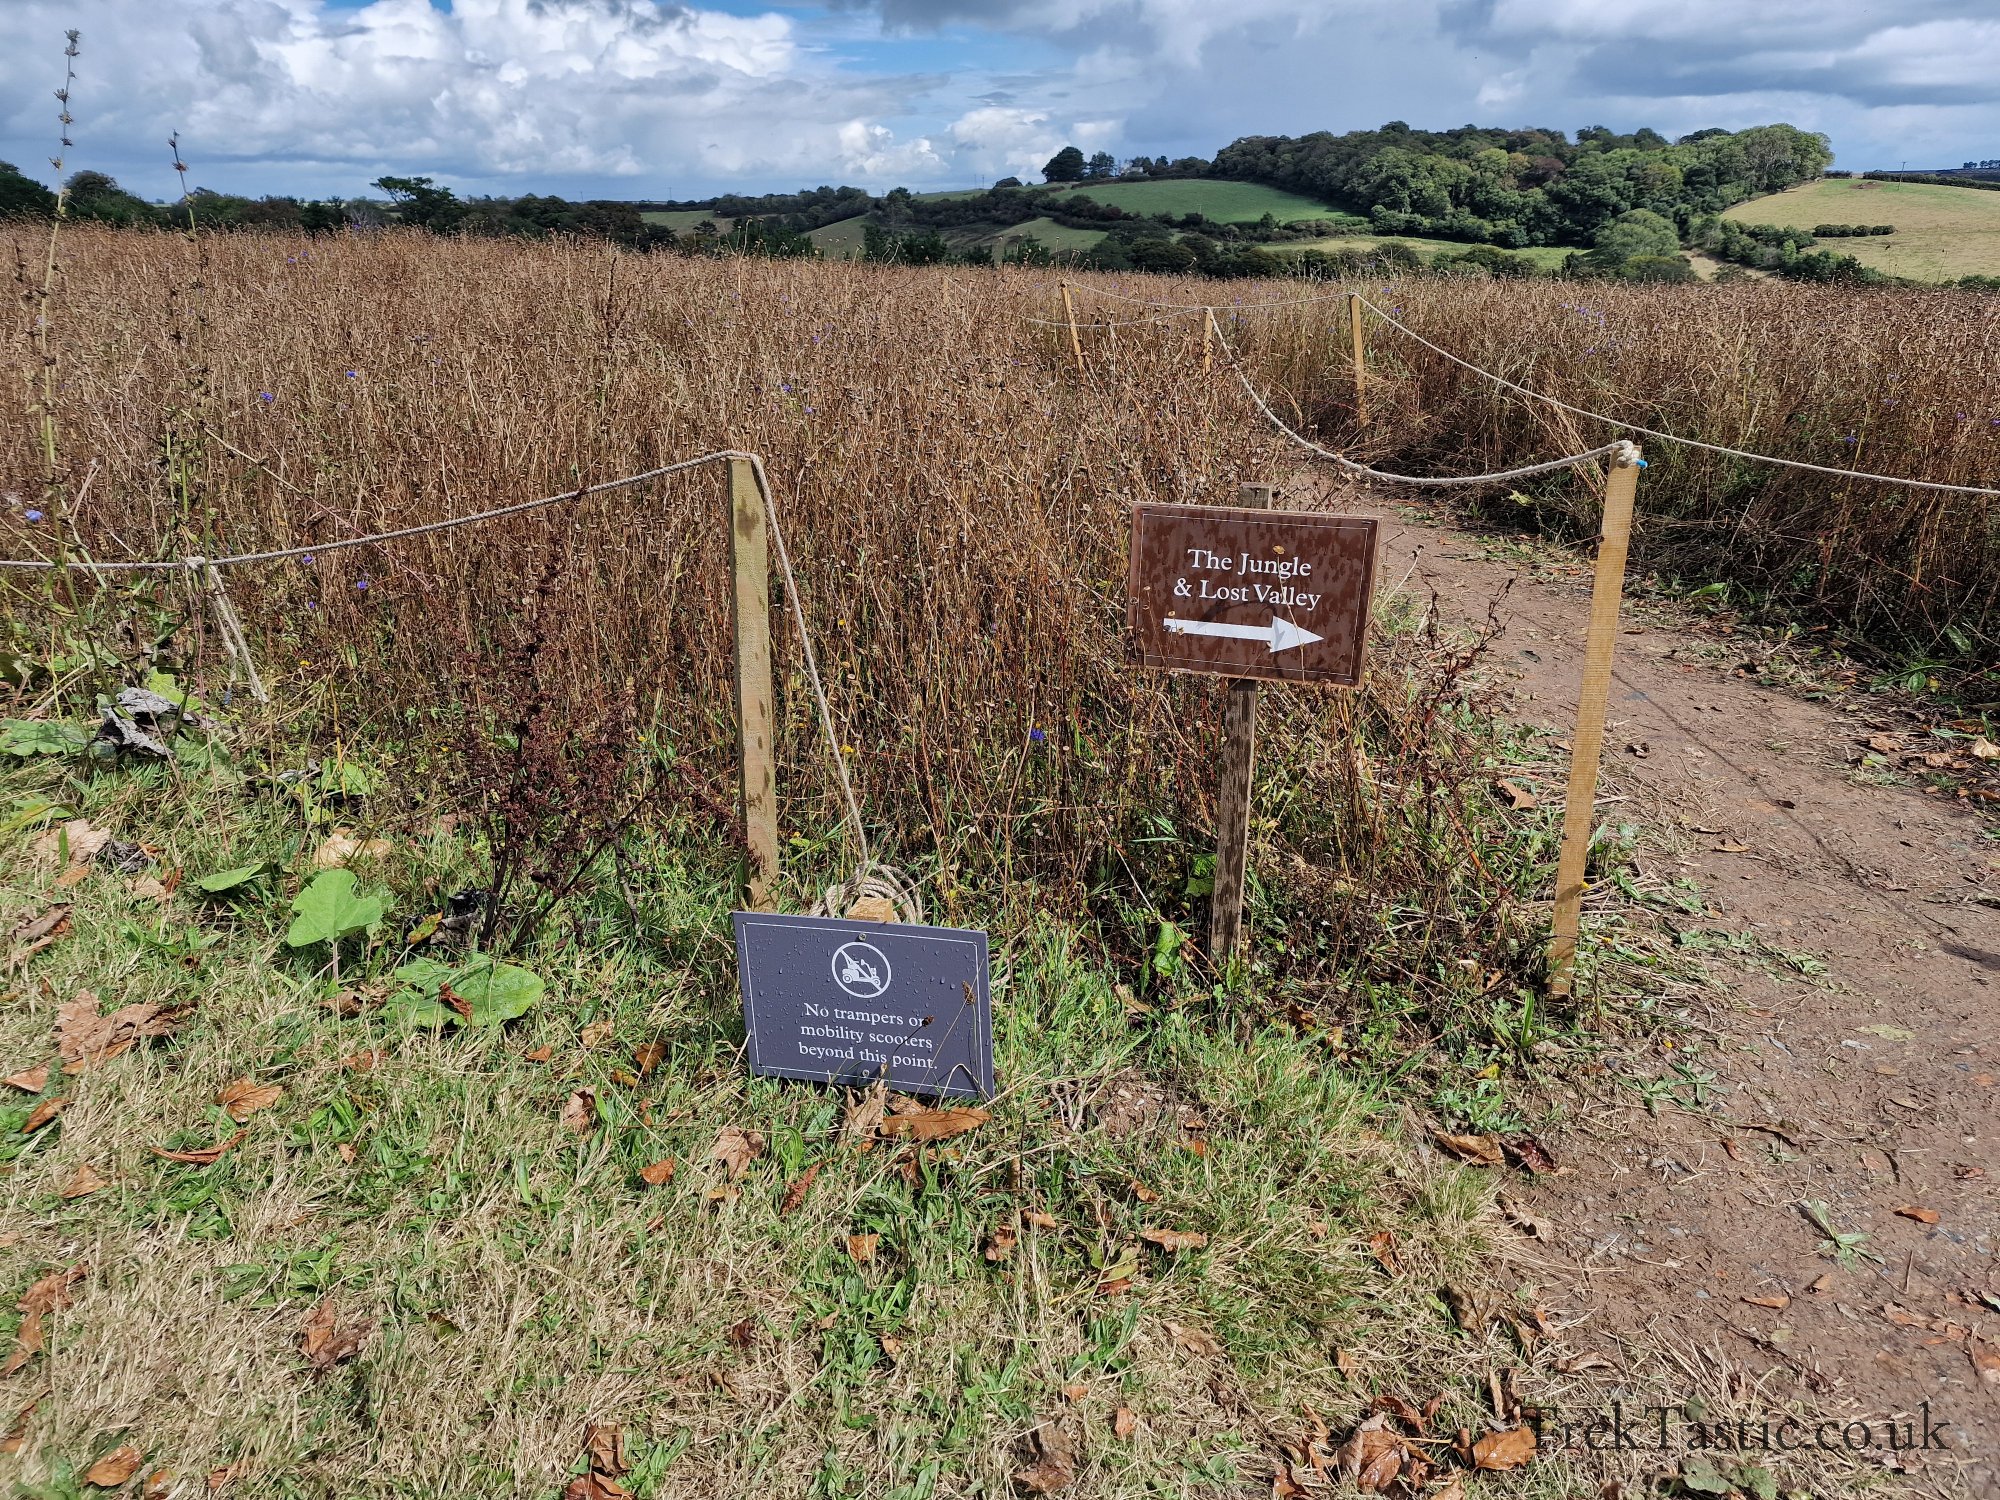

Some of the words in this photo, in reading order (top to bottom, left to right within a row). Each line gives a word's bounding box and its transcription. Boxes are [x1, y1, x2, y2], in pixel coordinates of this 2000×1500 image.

[1187, 548, 1232, 571] The
[1237, 553, 1312, 579] Jungle
[1173, 577, 1192, 597] &
[1199, 580, 1249, 602] Lost
[1253, 584, 1322, 611] Valley
[803, 1002, 829, 1017] No
[834, 1008, 904, 1025] trampers
[800, 1024, 865, 1043] mobility
[869, 1032, 933, 1049] scooters
[798, 1041, 855, 1059] beyond
[859, 1048, 888, 1063] this
[892, 1053, 938, 1070] point.
